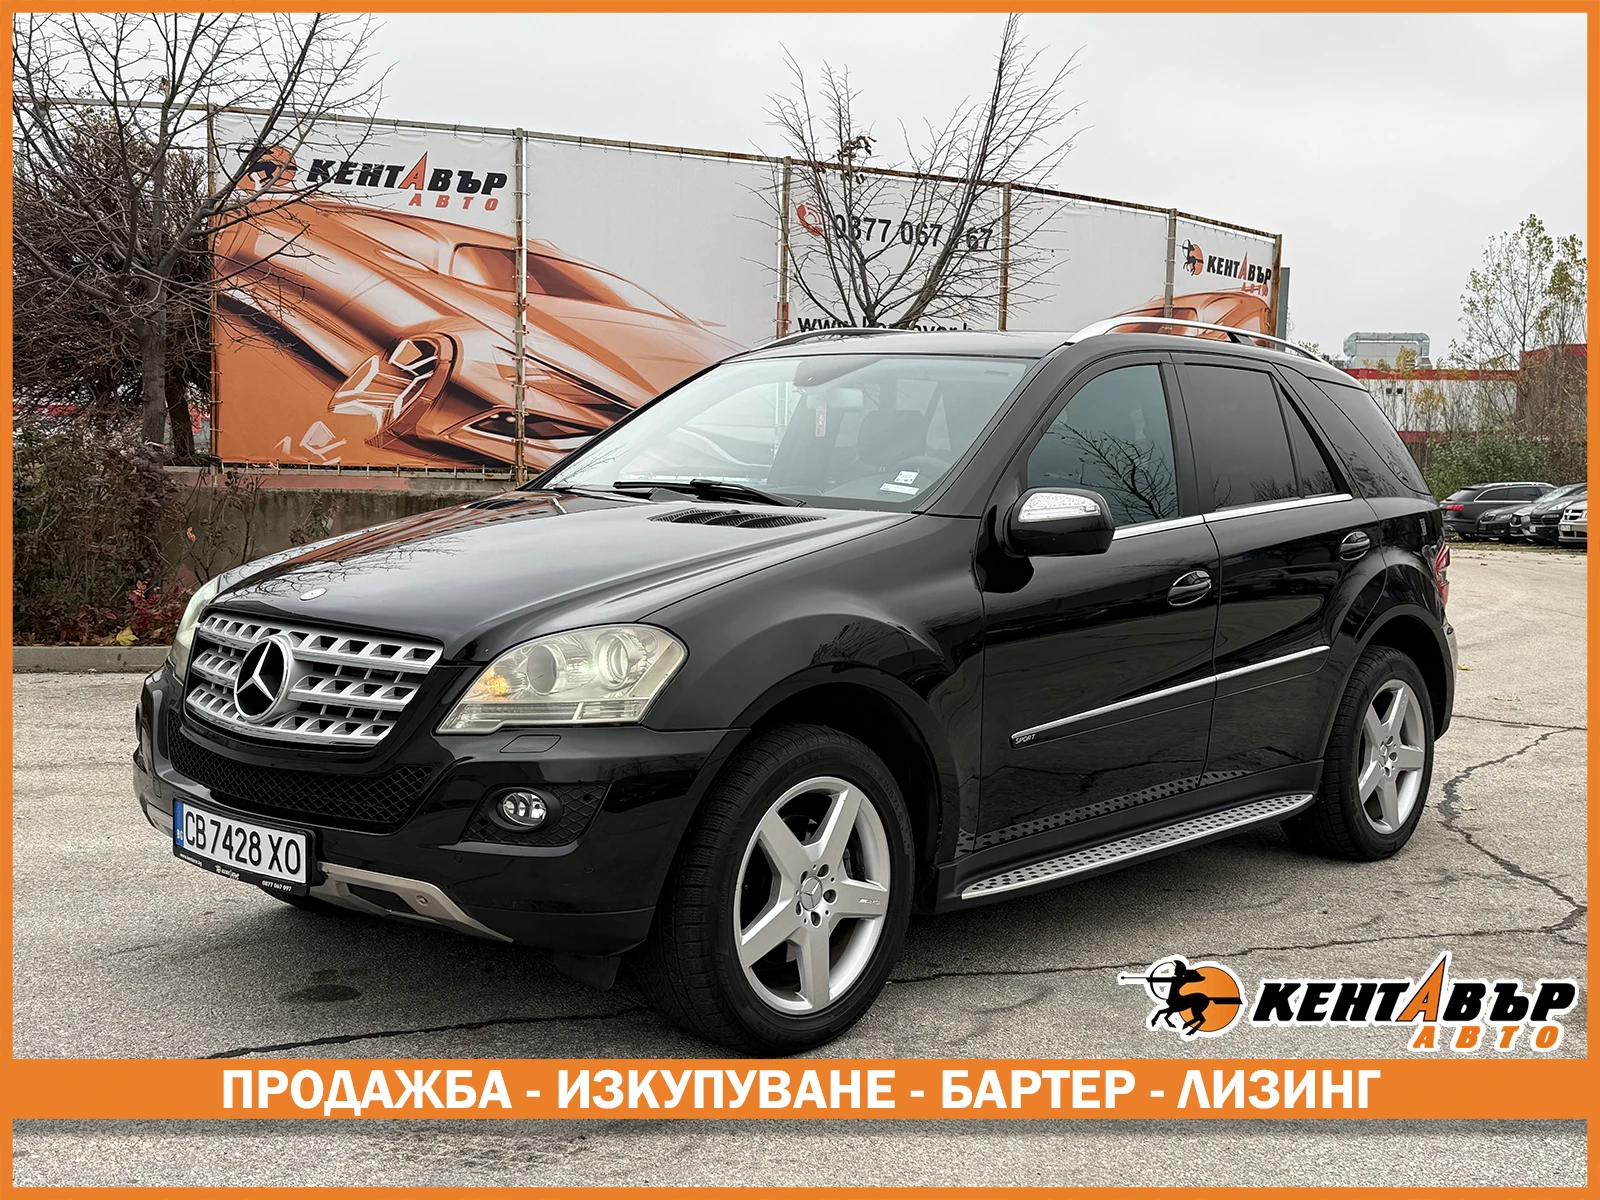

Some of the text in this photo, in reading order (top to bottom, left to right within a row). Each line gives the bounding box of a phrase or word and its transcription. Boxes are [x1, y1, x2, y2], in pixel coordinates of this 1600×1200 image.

[306, 151, 508, 195] КЕНТАВЪР
[408, 193, 499, 211] АВТО
[901, 221, 943, 248] 067
[1206, 251, 1272, 285] КЕНТАВЪР
[1015, 733, 1036, 745] SPORT
[210, 819, 261, 866] 7428
